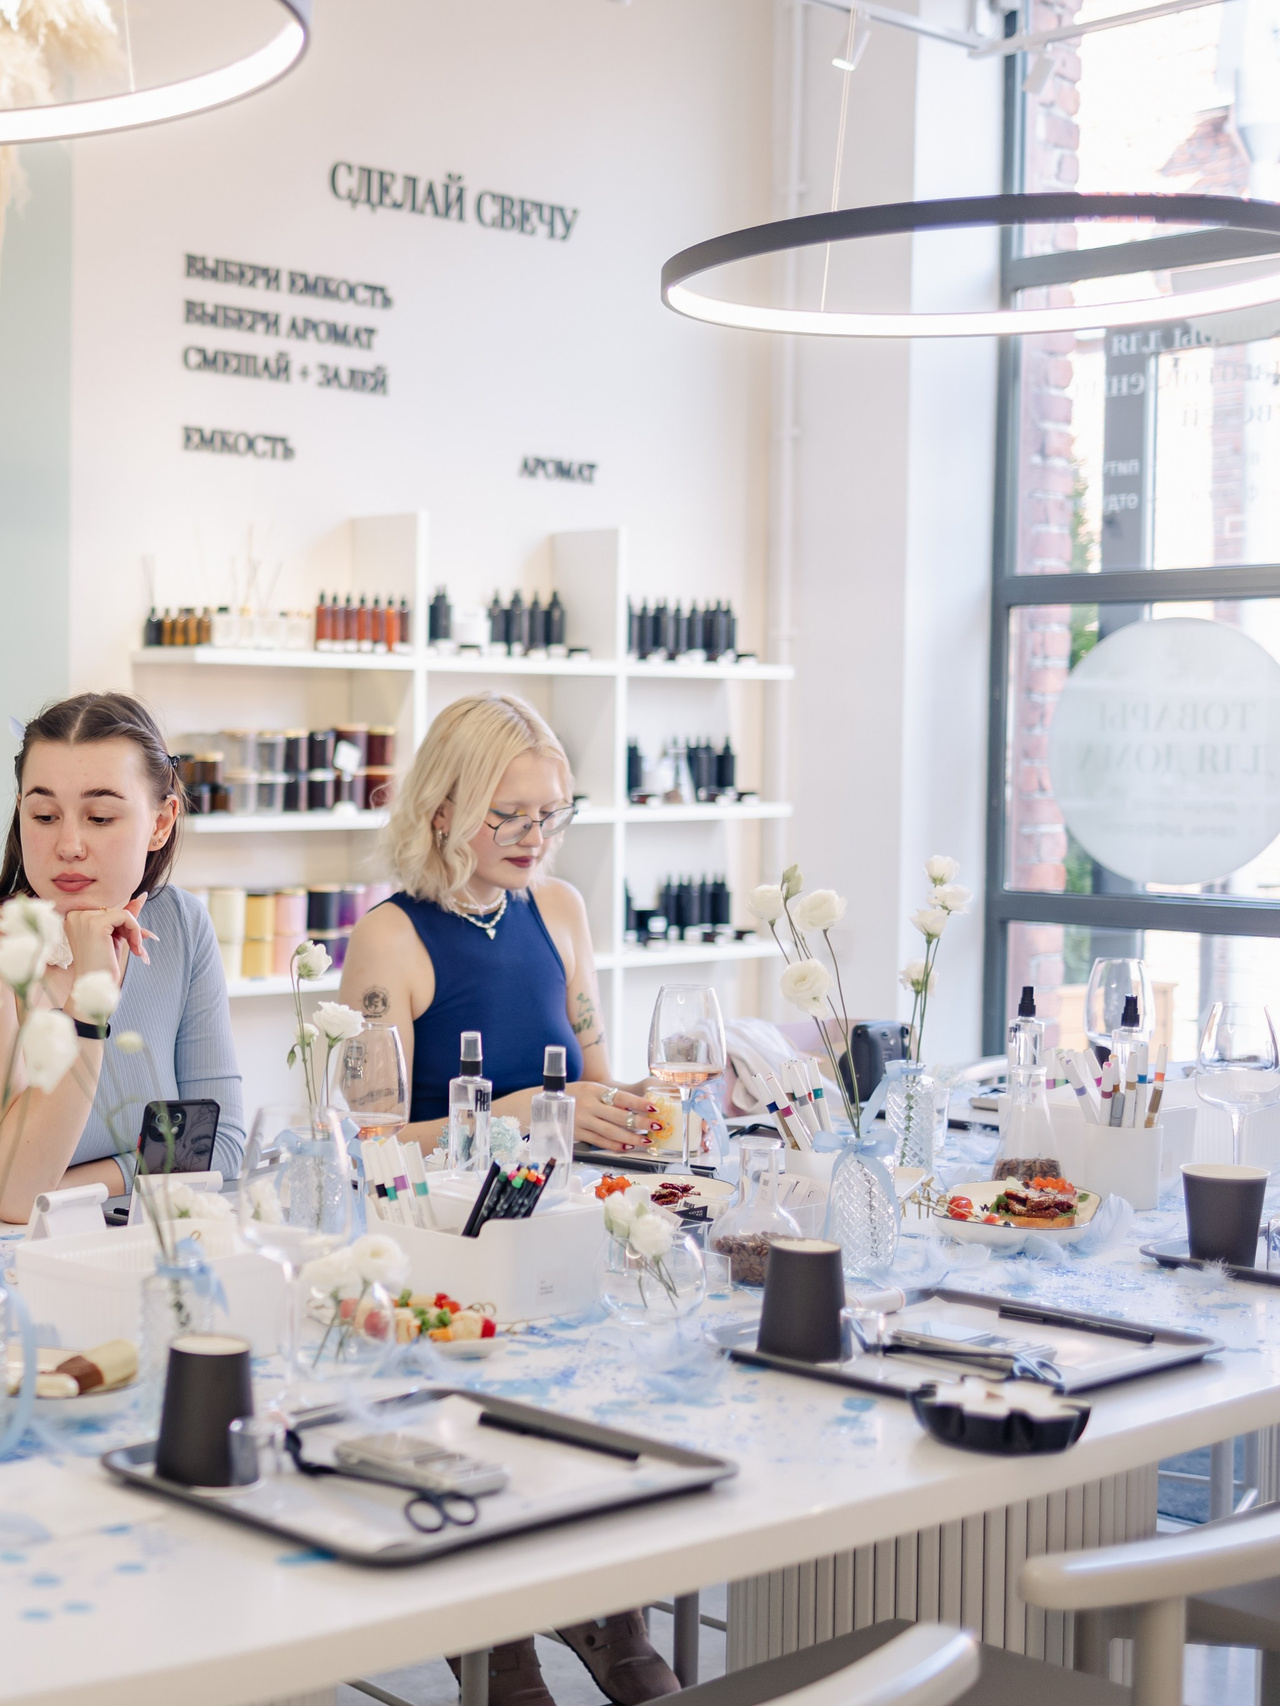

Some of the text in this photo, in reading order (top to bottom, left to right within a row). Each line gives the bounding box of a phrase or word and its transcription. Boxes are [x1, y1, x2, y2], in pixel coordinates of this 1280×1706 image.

[328, 160, 580, 242] СДЕЛАЙ СВЕЧУ
[183, 252, 394, 310] ВЫБЕРИ ЕМКОСТЬ
[183, 299, 377, 350] ВЫБЕРИ АРОМАТ
[182, 345, 291, 383] СМЕШАЙ
[317, 362, 389, 396] ЗАЛЕЙ
[182, 425, 296, 461] ЕМКОСТЬ
[520, 455, 598, 484] АРОМАТ
